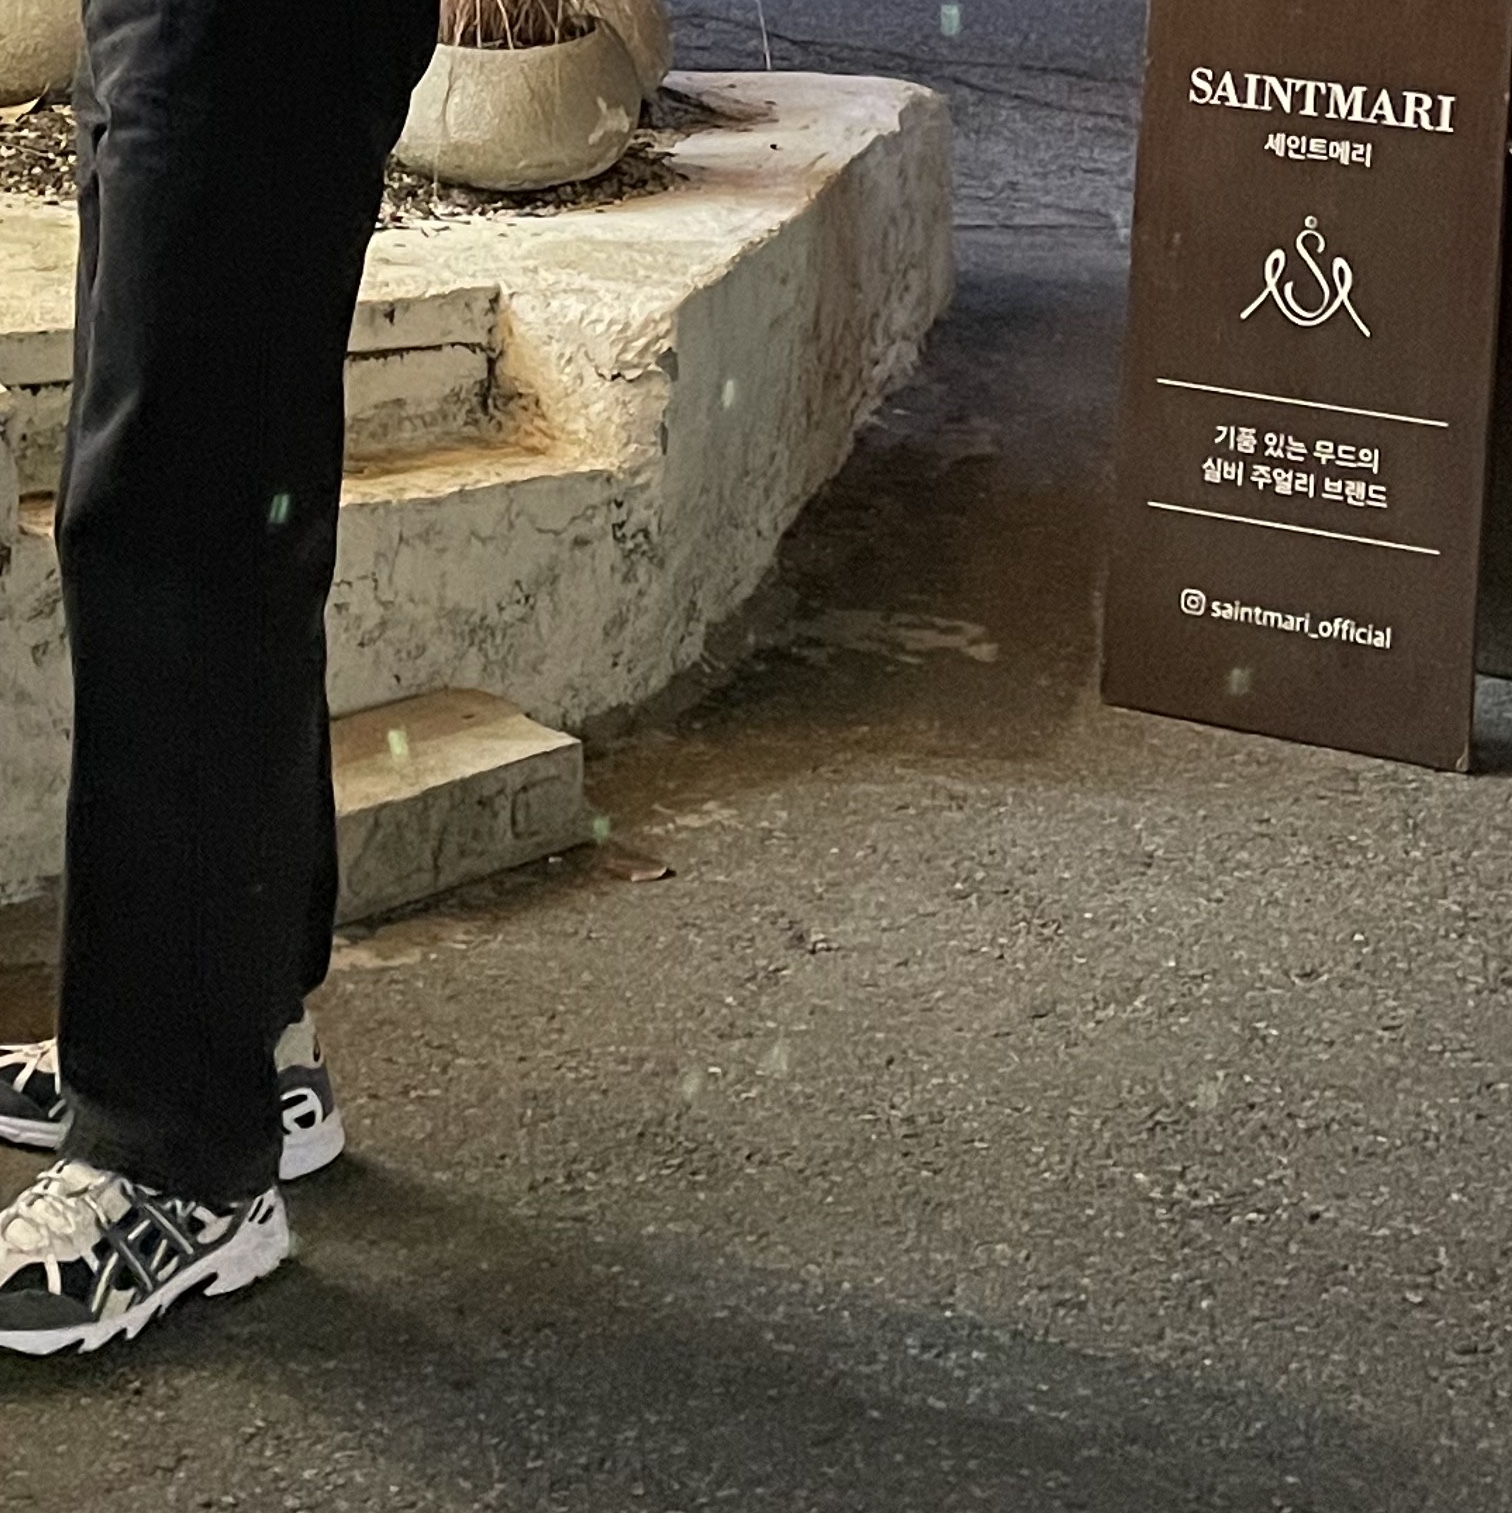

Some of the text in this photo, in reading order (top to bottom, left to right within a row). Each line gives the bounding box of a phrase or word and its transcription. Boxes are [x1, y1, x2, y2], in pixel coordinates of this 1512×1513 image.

[1188, 66, 1457, 133] SAINTMARI
[1263, 132, 1372, 168] 세인트메리
[1214, 425, 1380, 475] 기품 있는 무드의
[1250, 464, 1315, 499] 주얼리
[1321, 477, 1388, 508] 브랜드
[1210, 599, 1392, 650] saintmari_official
